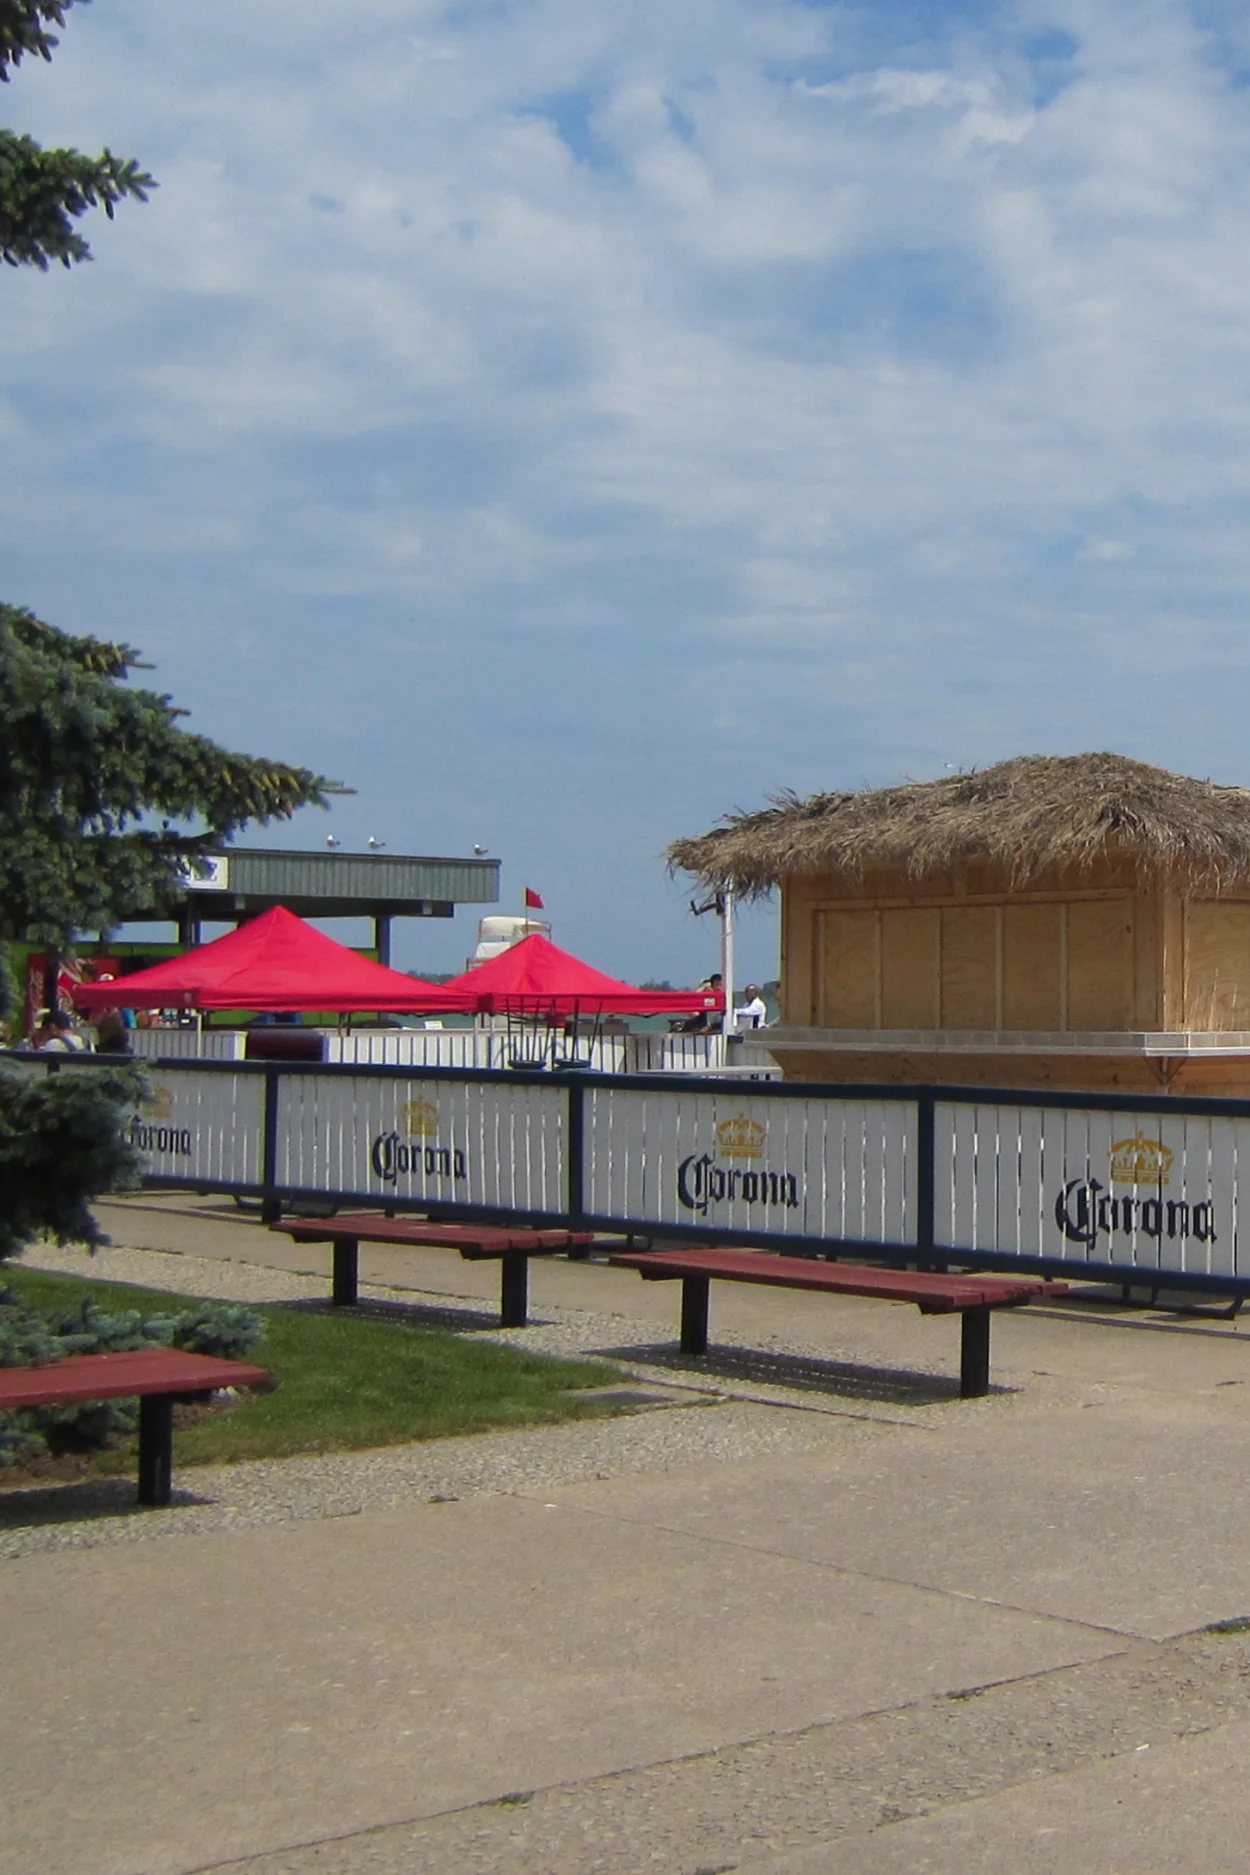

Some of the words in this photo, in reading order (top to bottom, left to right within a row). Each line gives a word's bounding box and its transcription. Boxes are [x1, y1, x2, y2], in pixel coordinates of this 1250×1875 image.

[372, 1131, 467, 1186] Corona
[678, 1153, 799, 1216] Corona
[1055, 1178, 1217, 1250] Corona
